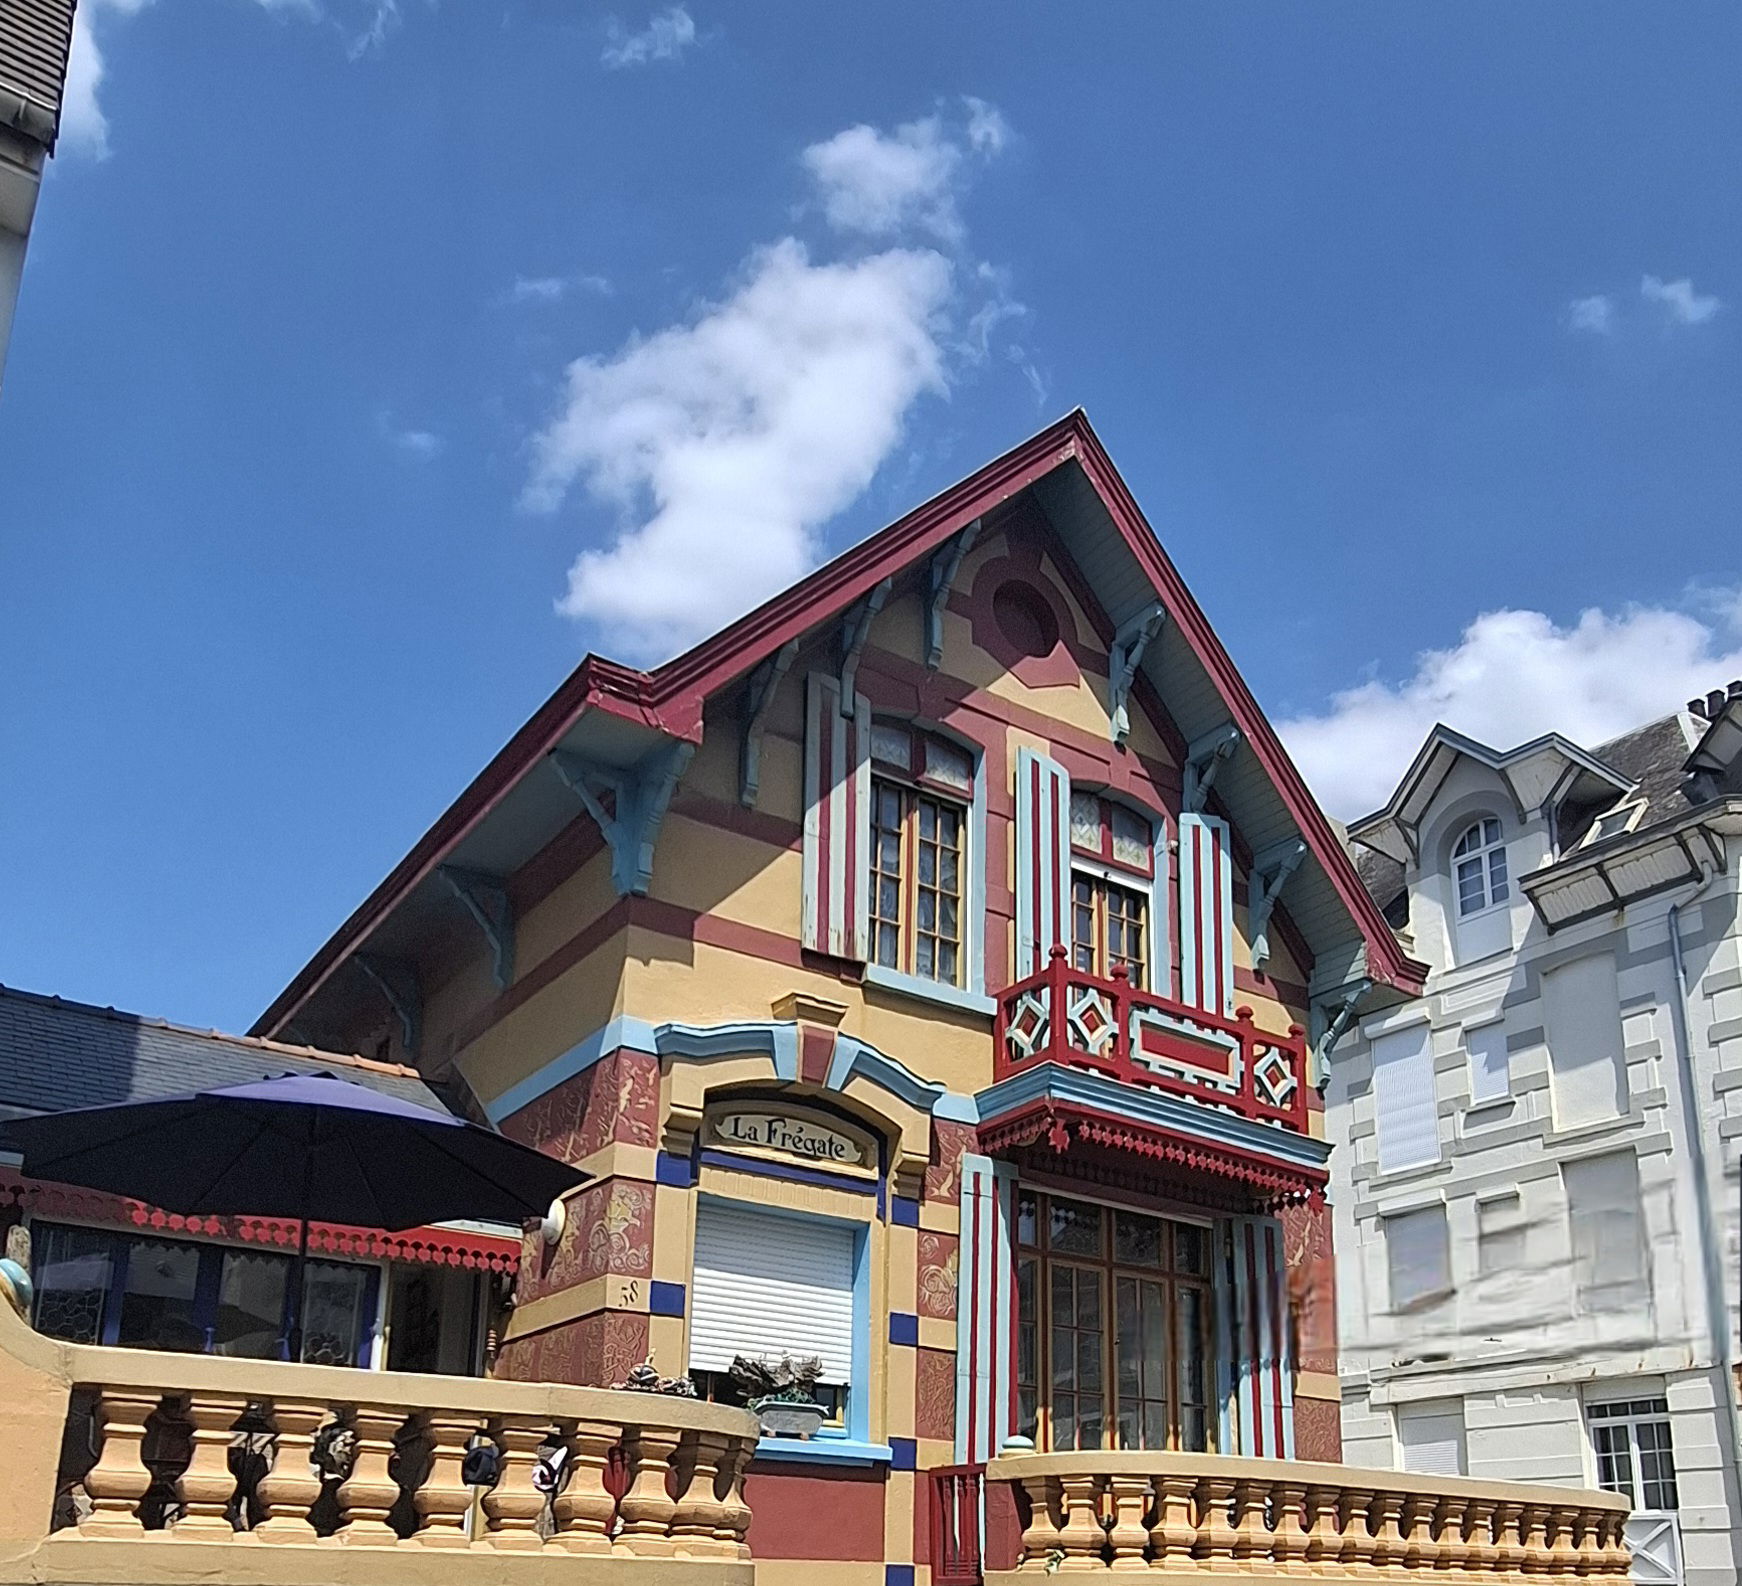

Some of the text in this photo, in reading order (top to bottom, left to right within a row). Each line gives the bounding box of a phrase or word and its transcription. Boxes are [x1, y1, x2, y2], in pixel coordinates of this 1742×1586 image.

[729, 1117, 845, 1160] La Frégate
[618, 1280, 639, 1307] 58
